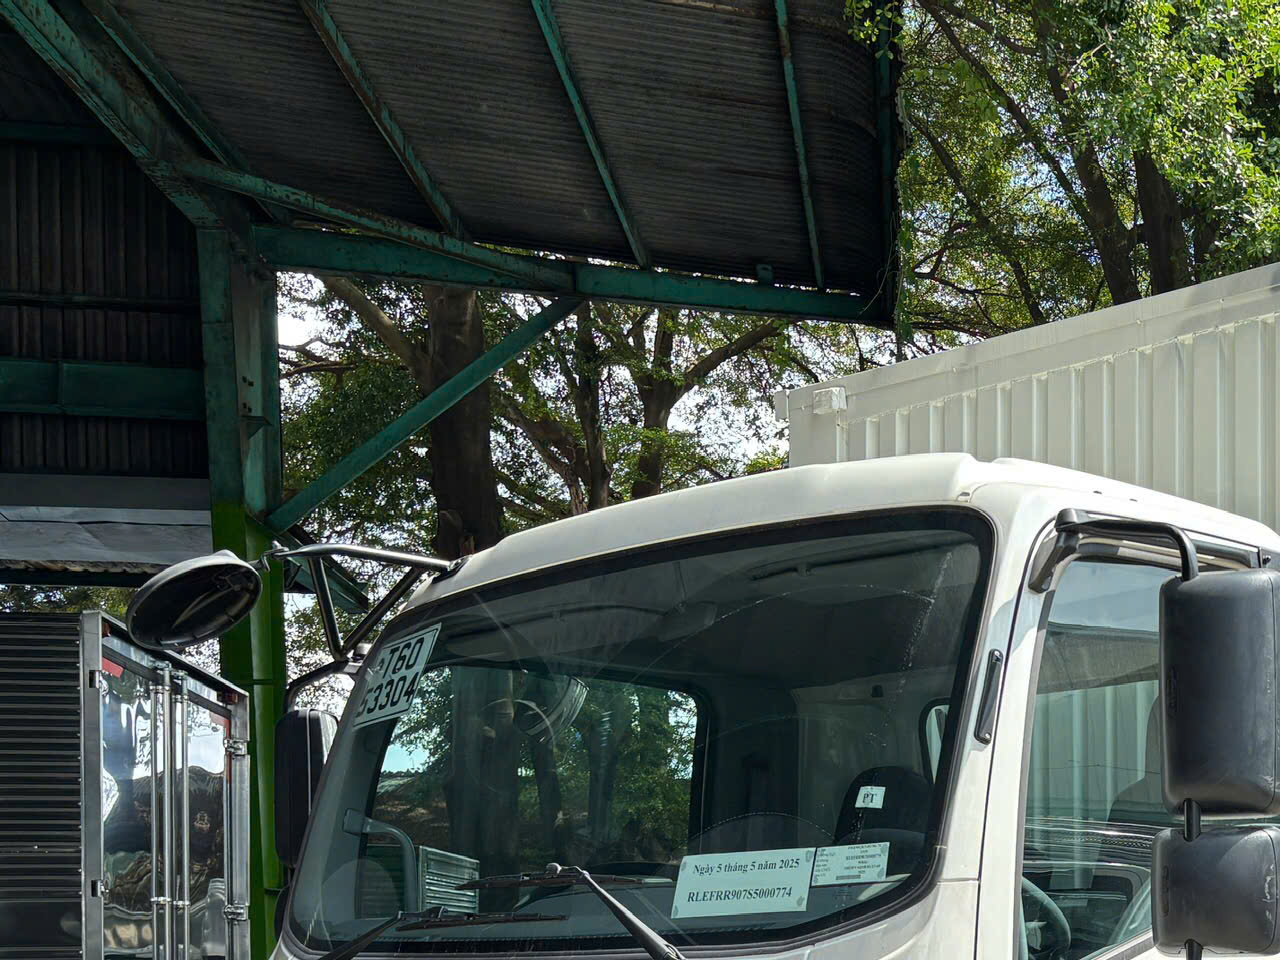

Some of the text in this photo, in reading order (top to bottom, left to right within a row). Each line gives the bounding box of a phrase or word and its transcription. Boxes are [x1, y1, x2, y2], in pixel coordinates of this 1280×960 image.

[693, 858, 800, 876] Ngày 5 tháng 5 năm 2025
[687, 886, 793, 903] RLEFRR907S5000774
